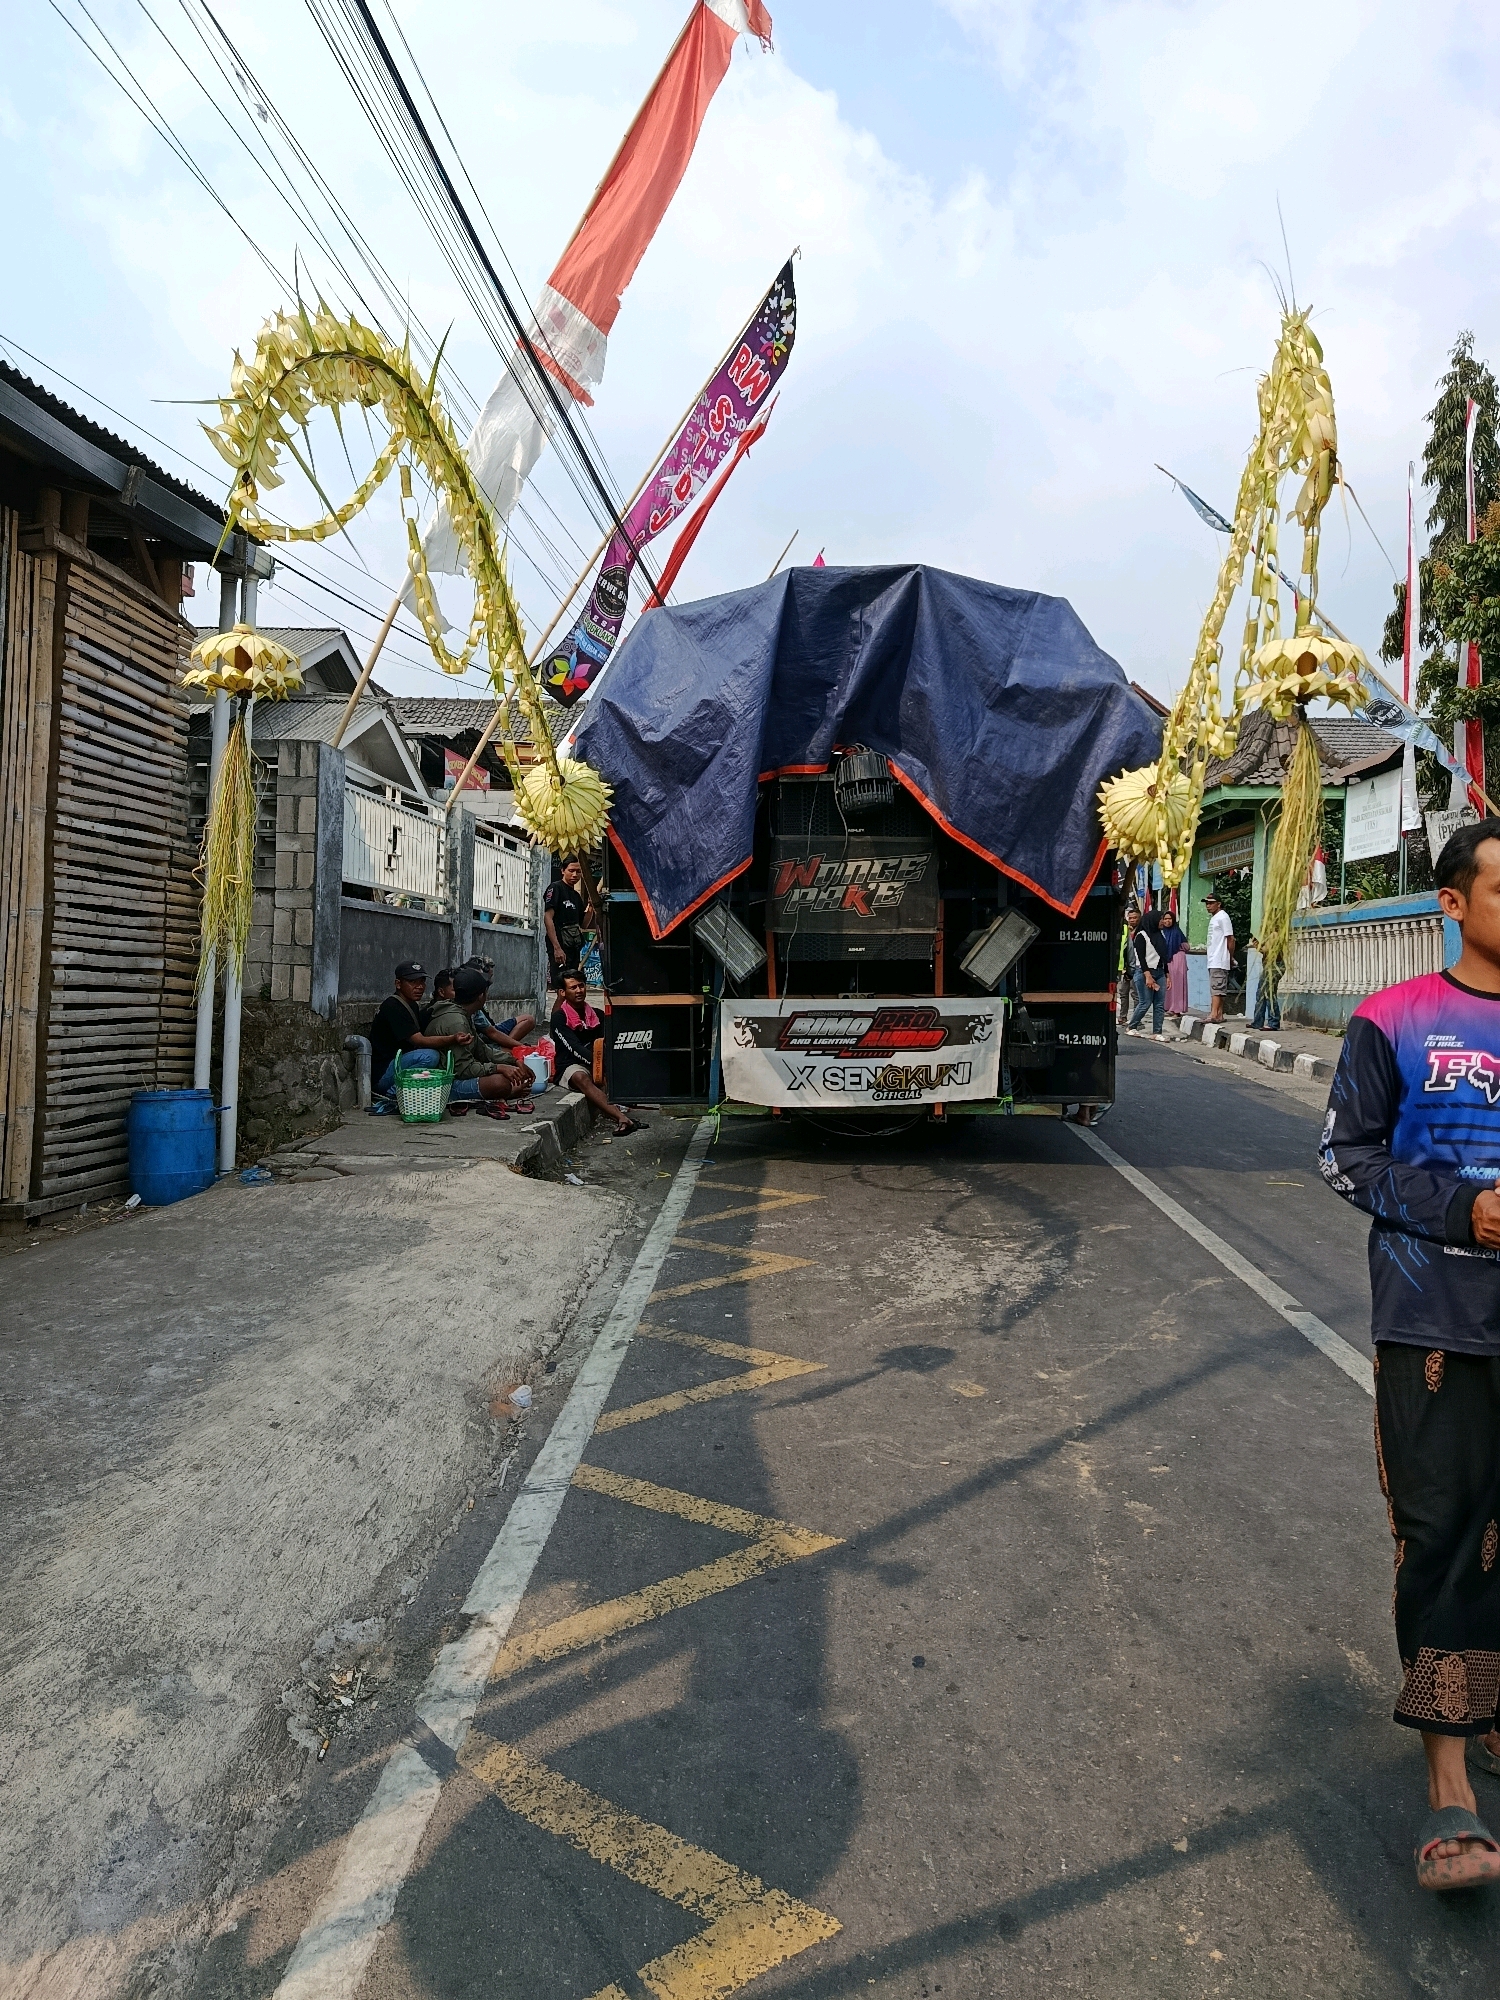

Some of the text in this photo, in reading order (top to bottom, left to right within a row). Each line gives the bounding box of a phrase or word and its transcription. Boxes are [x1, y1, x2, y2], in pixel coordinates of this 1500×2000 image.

[728, 342, 771, 407] RW
[786, 1012, 930, 1036] BIMO PRO
[813, 1037, 857, 1045] LIGHTING
[857, 1030, 944, 1047] AUDIO
[784, 1060, 972, 1095] X SENGKUNI
[873, 1089, 923, 1101] OFFICIAL
